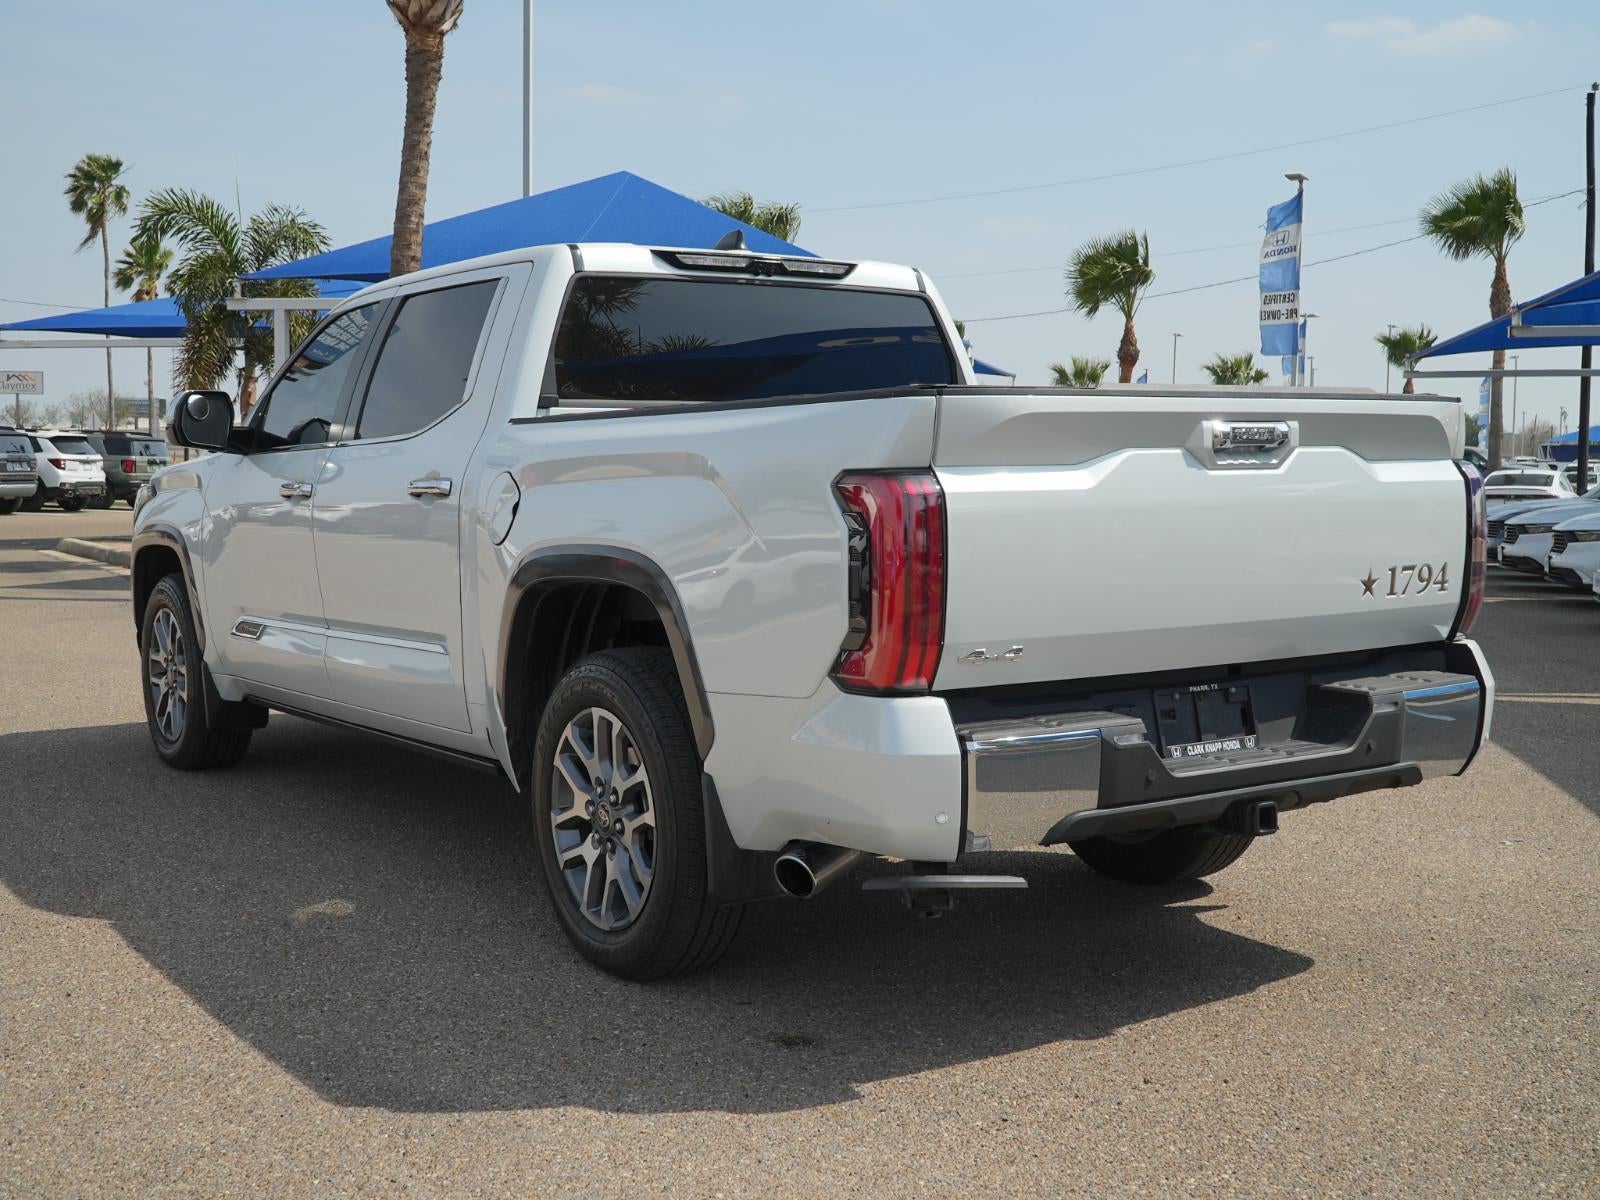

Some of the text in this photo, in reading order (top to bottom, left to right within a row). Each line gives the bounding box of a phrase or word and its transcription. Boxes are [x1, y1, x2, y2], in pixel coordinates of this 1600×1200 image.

[1386, 561, 1449, 597] 1794
[1187, 740, 1240, 756] CLARK KNAPP HONDA
